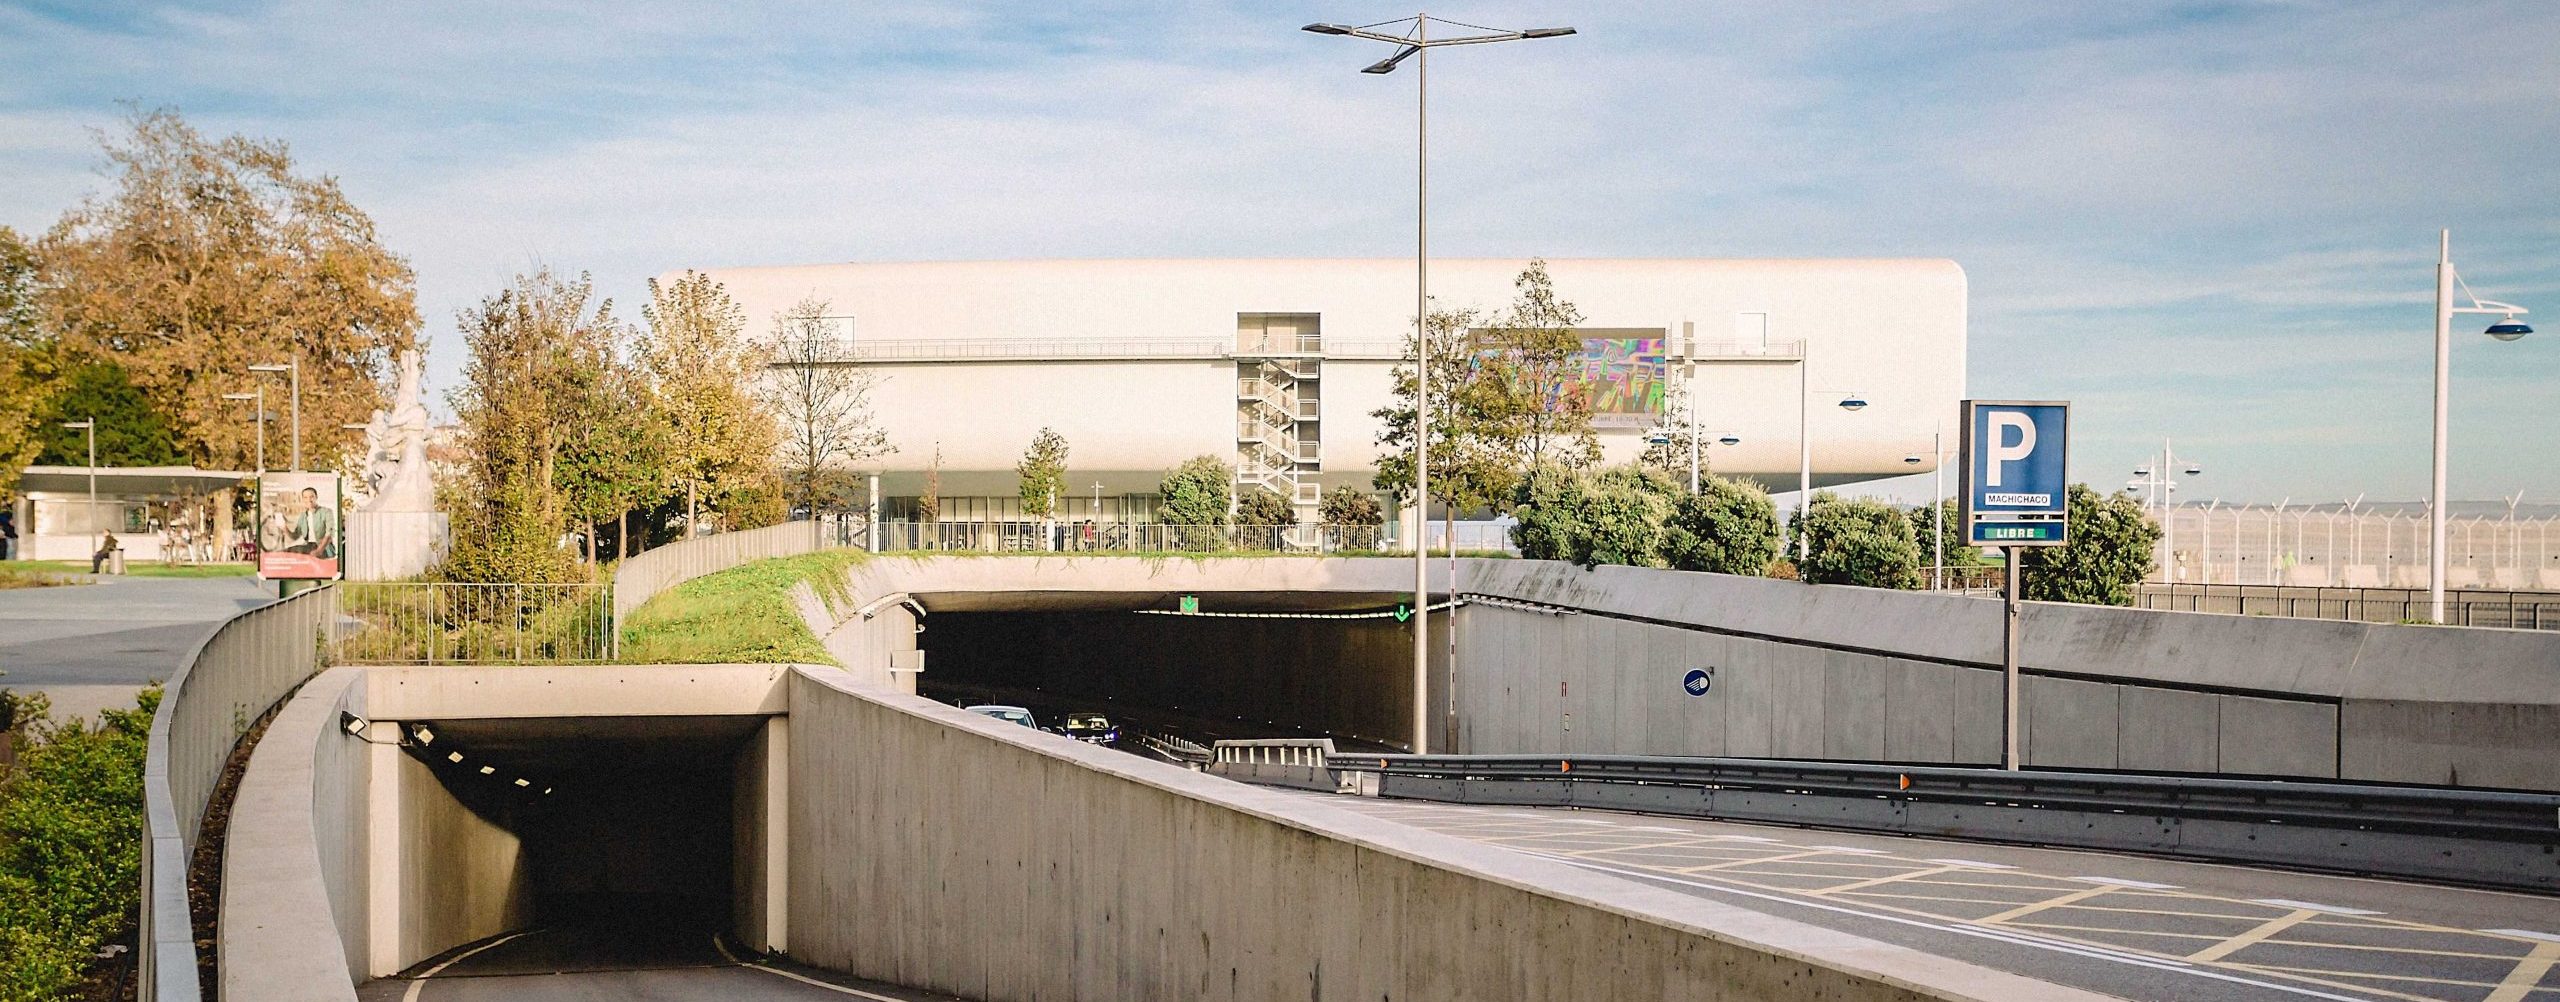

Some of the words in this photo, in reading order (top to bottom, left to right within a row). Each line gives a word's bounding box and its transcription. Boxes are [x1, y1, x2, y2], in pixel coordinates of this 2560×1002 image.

[1986, 411, 2037, 486] P
[1988, 495, 2048, 504] MACHICHACO
[1996, 528, 2034, 538] LIBRE
